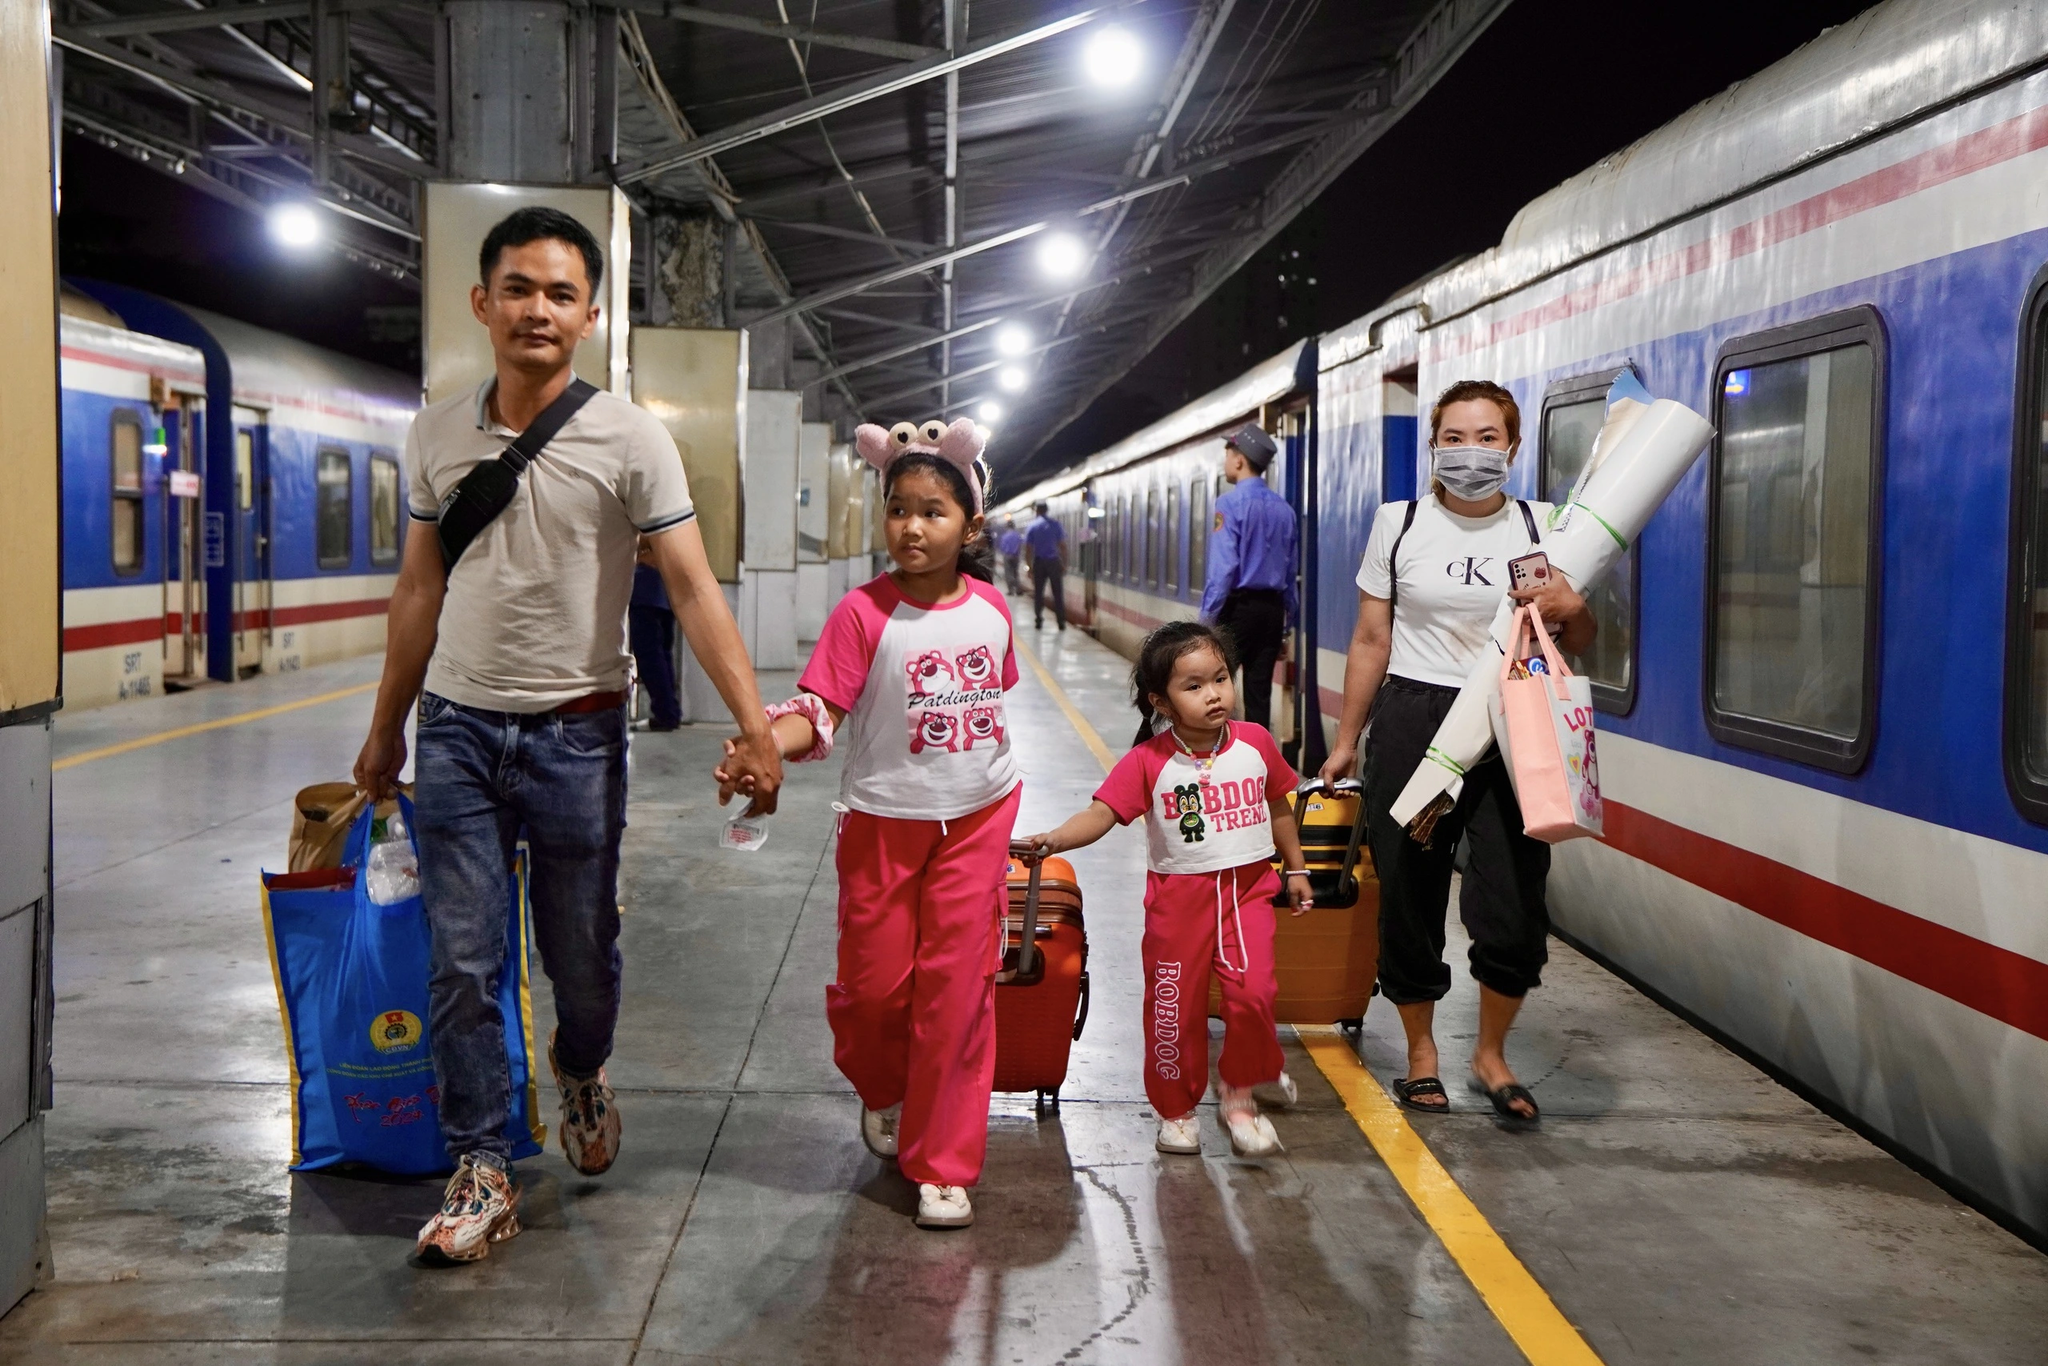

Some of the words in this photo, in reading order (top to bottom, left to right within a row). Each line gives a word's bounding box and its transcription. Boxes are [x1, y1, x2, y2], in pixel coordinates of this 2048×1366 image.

[125, 652, 142, 674] SRT
[908, 688, 1001, 709] Patdington
[1155, 960, 1181, 1079] BOBDOG
[381, 1109, 423, 1127] 2024
